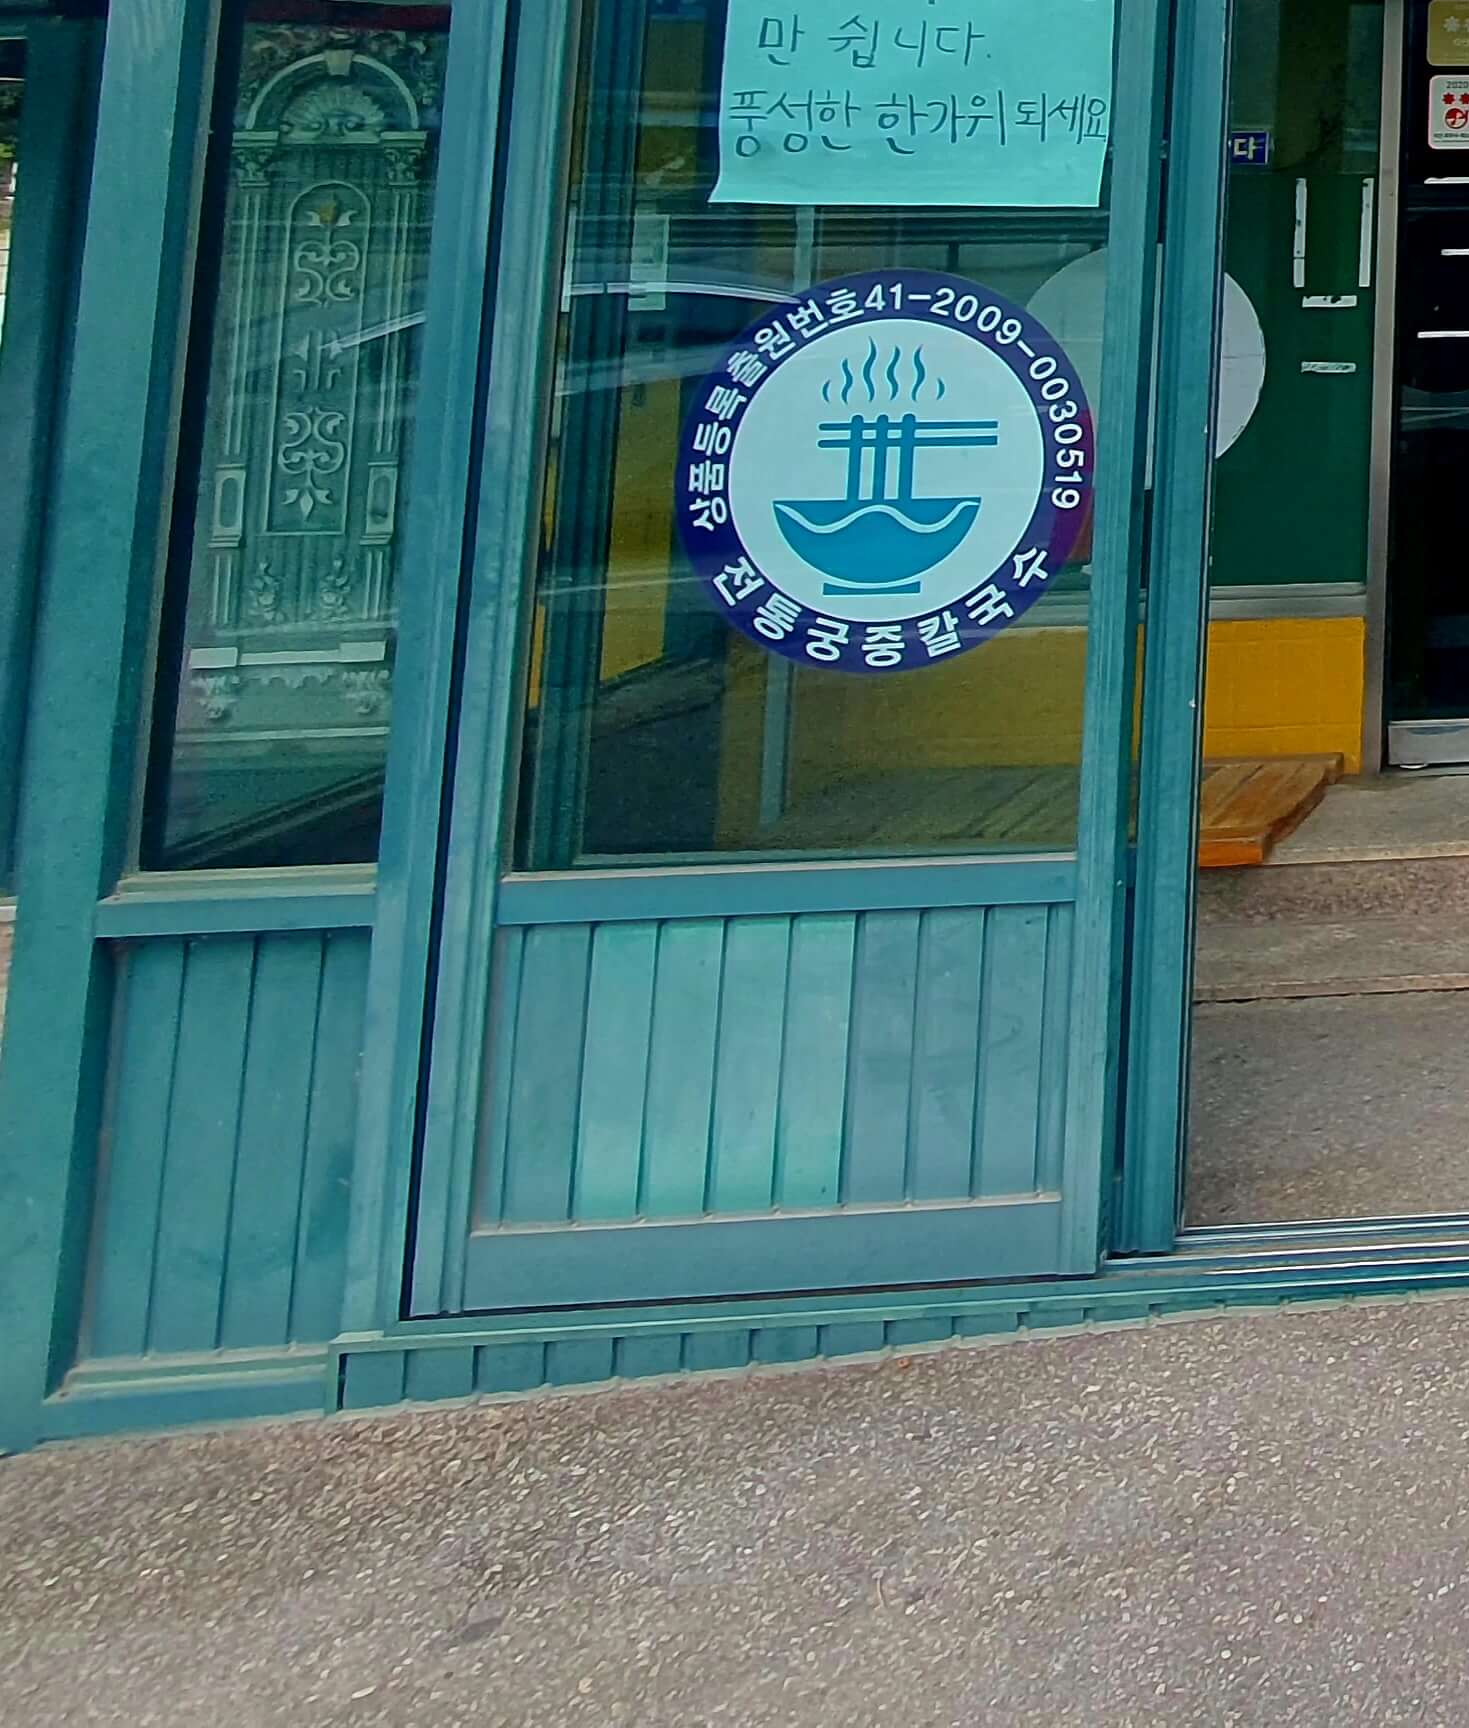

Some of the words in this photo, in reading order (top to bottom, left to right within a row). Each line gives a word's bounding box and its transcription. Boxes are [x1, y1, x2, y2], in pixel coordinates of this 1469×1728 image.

[758, 14, 805, 66] 만
[828, 14, 992, 69] 쉽니다.
[729, 88, 861, 158] 풍성한
[875, 89, 1007, 155] 한가위
[1014, 91, 1108, 145] 되세요
